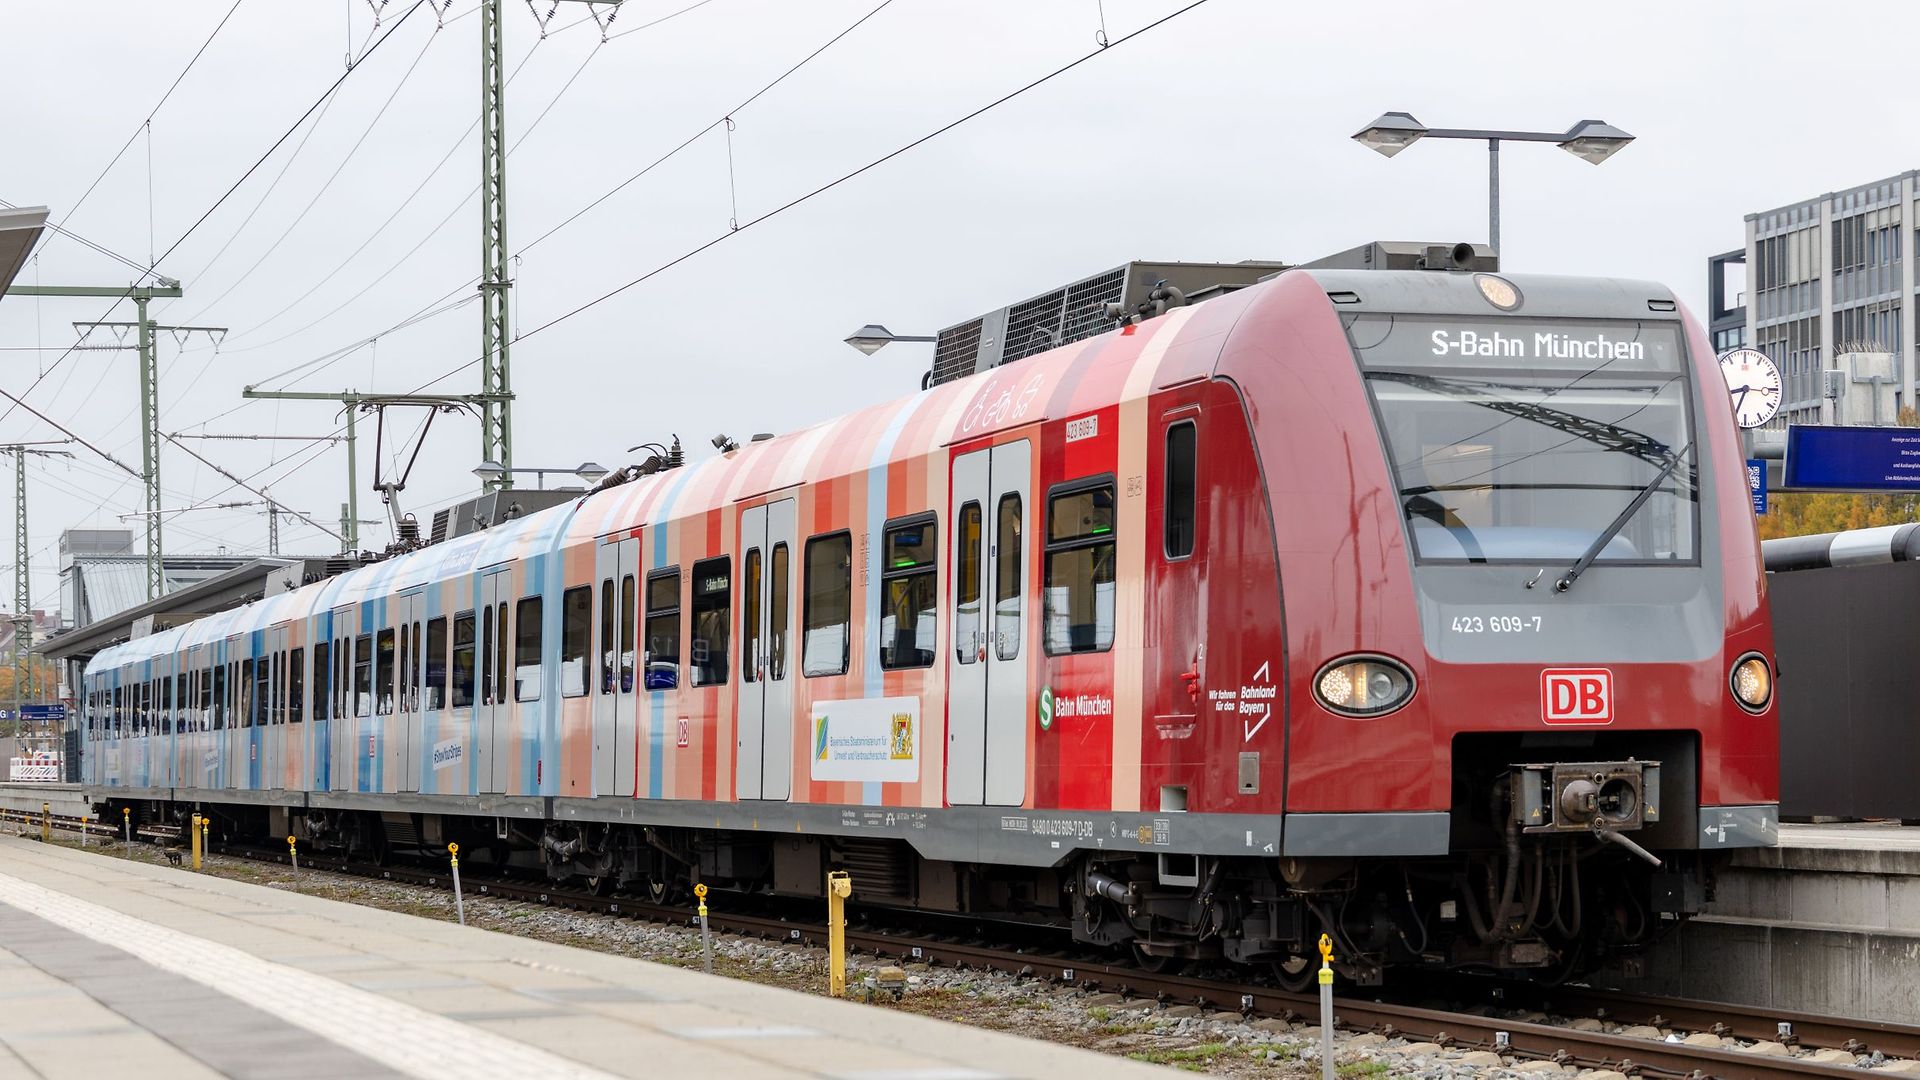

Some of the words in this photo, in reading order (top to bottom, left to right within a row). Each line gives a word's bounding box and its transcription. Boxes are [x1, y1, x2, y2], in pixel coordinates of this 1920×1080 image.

[1431, 329, 1525, 357] S-Bahn
[1534, 331, 1644, 360] München
[1067, 423, 1078, 439] 423
[1079, 418, 1096, 436] 609-7
[1451, 616, 1484, 633] 423
[1489, 615, 1543, 633] 609-7
[1208, 690, 1218, 700] Wir
[1218, 689, 1237, 700] fahren
[1240, 684, 1277, 699] Bahnland
[1550, 678, 1605, 715] DB
[1040, 688, 1052, 727] S
[1055, 696, 1075, 717] Bahn
[1076, 694, 1112, 716] München
[1215, 700, 1224, 711] für
[1223, 701, 1235, 711] das
[1239, 700, 1265, 717] Bayern
[679, 720, 688, 743] DB
